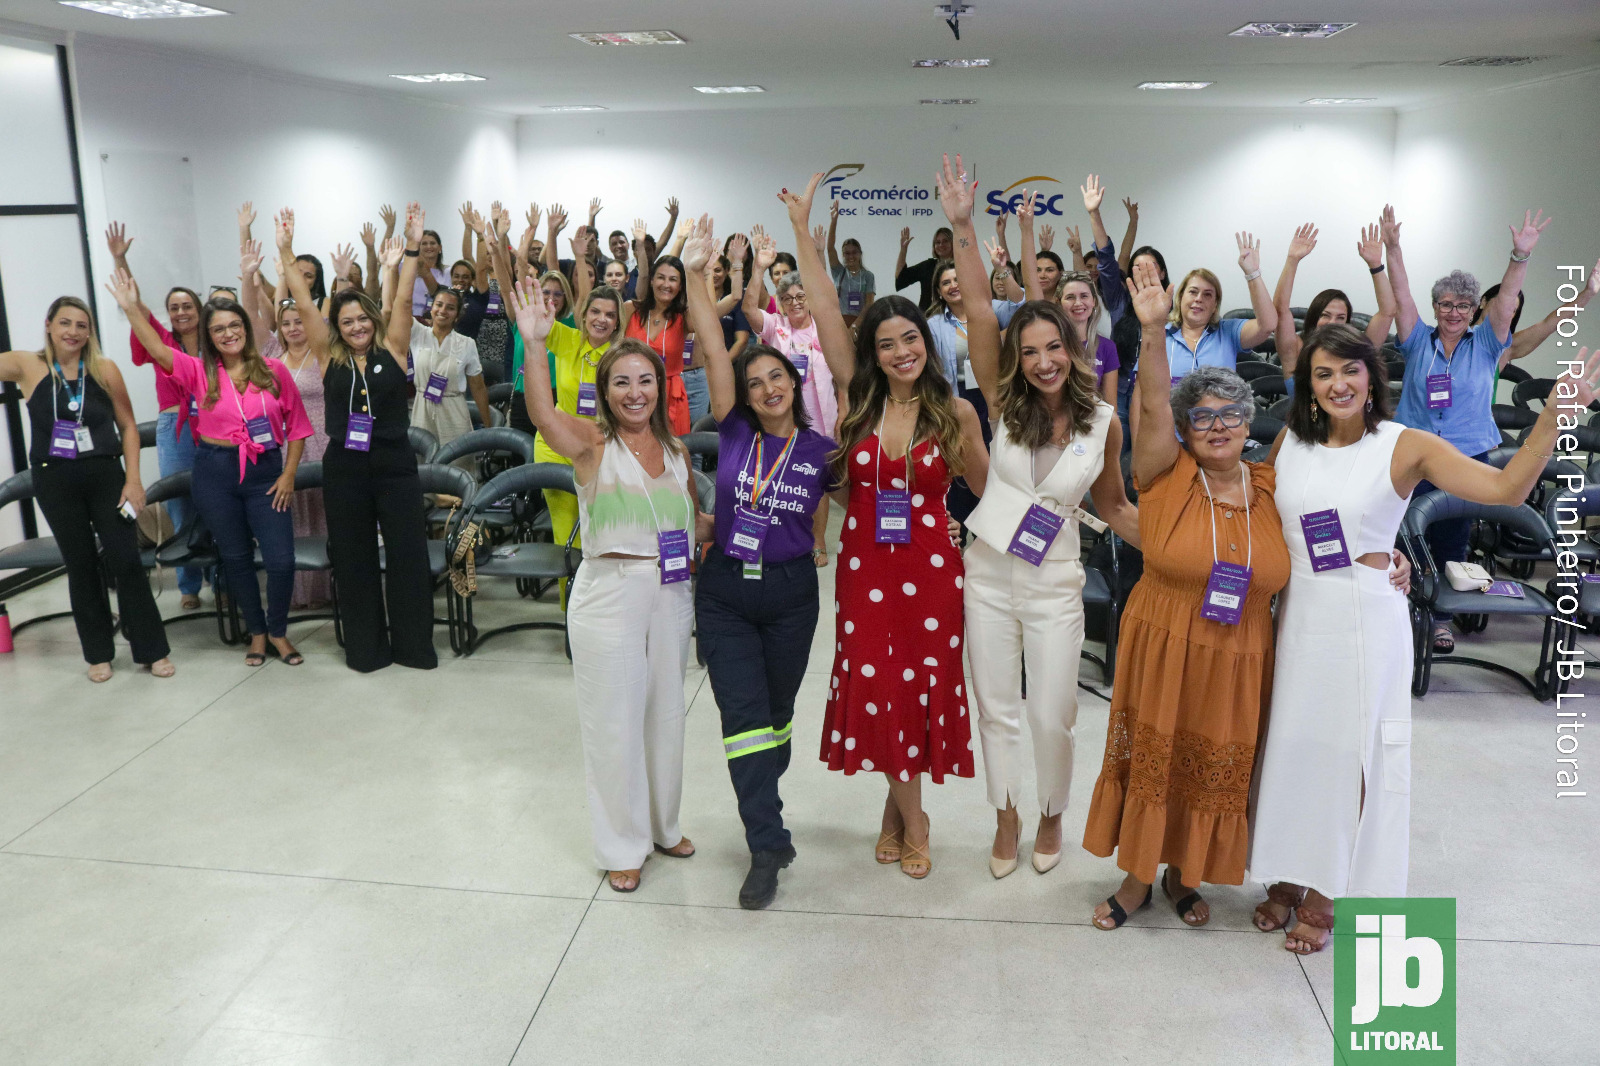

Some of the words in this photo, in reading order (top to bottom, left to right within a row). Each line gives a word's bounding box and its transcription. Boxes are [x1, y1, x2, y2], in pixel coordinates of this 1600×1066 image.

[831, 185, 929, 201] Fecomércio
[837, 206, 857, 217] esc
[868, 205, 902, 217] Senac
[912, 208, 933, 217] IFPD
[791, 462, 819, 476] Cargill
[772, 480, 811, 499] Vinda.
[735, 486, 805, 514] Valrizada.
